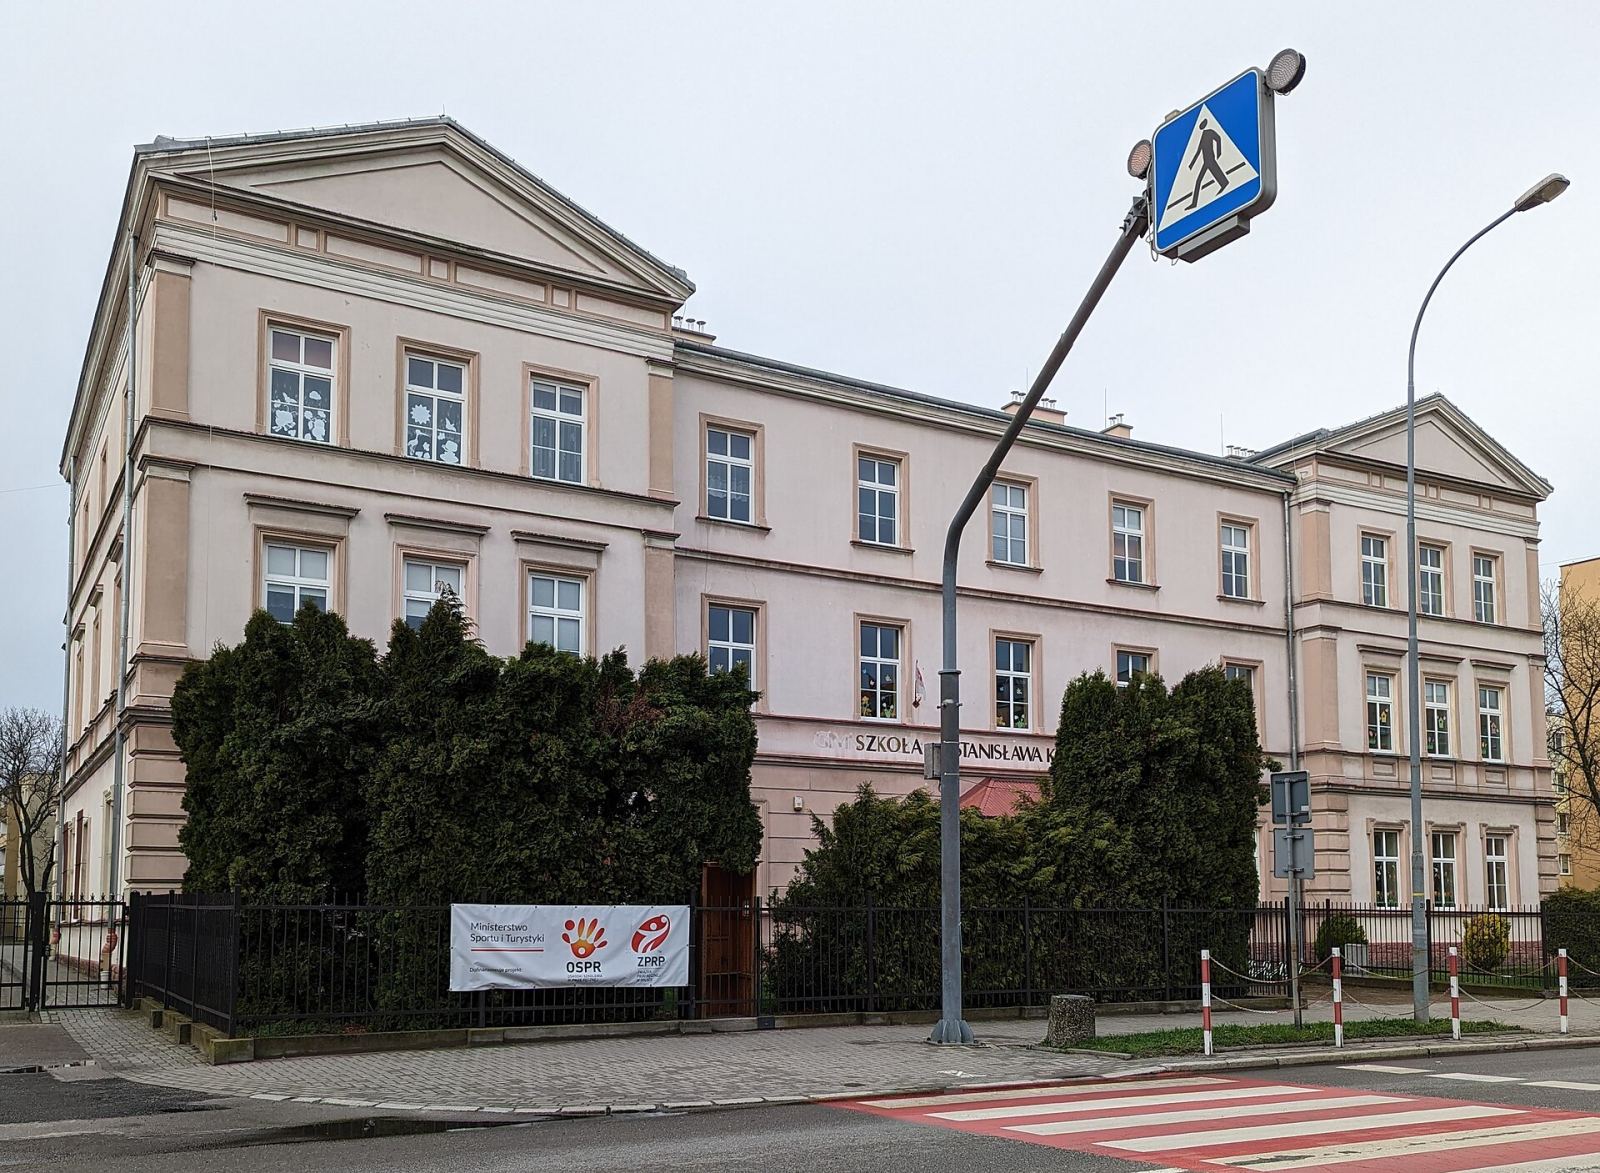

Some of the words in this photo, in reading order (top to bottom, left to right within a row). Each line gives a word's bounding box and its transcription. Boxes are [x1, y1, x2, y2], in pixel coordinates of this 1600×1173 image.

[856, 734, 923, 755] SZKOŁA
[959, 741, 1043, 762] TANISŁAWA
[470, 922, 528, 931] Ministerstwo
[470, 933, 499, 943] Sportu
[506, 934, 545, 943] Turystyki
[566, 961, 601, 973] OSPR
[637, 956, 665, 967] ZPRP
